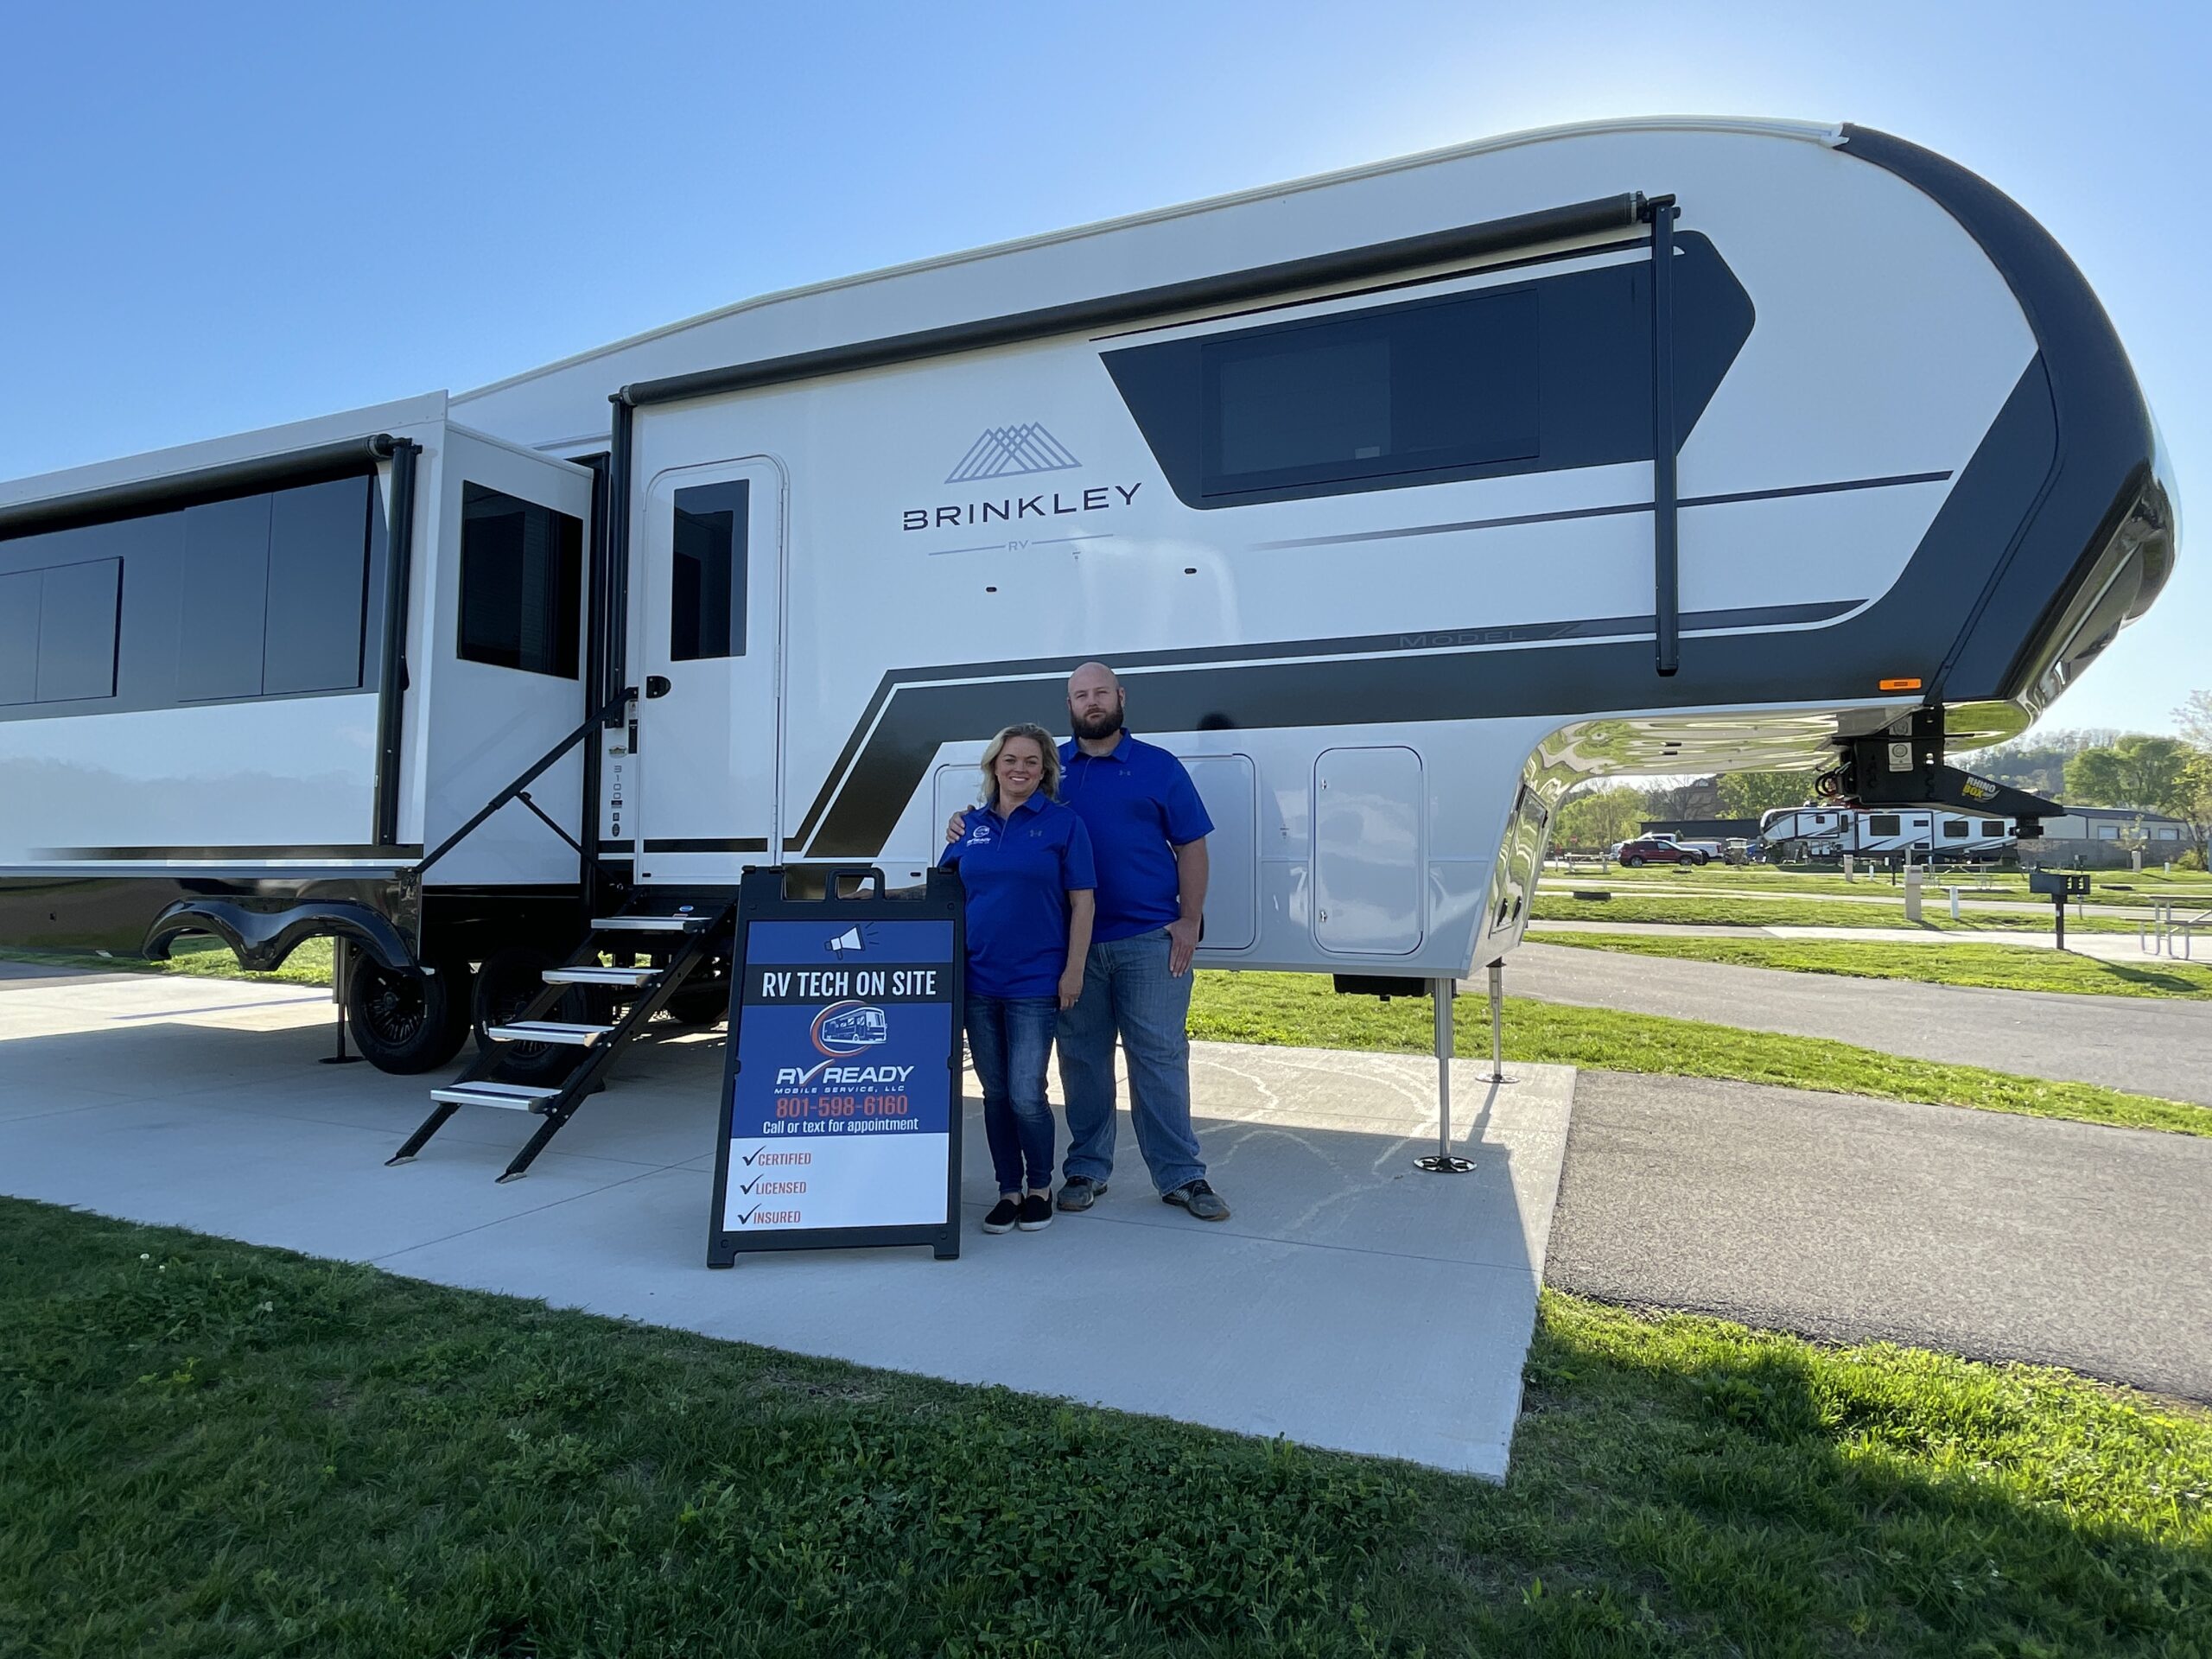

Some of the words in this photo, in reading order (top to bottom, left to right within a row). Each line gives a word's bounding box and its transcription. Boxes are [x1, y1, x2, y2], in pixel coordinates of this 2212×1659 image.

[903, 482, 1141, 531] BRINKLEY
[1008, 539, 1029, 551] RV
[1399, 632, 1528, 648] MODEL
[1548, 624, 1588, 639] Z
[1963, 785, 1984, 798] BOX
[1966, 776, 1996, 793] RHINO
[762, 972, 791, 997] RV
[797, 972, 849, 997] TECH
[856, 970, 885, 995] ON
[892, 970, 937, 995] SITE
[776, 1058, 836, 1086] RV
[823, 1065, 914, 1084] READY
[824, 1085, 878, 1094] SERVICE,
[776, 1095, 908, 1118] 801-598-6160
[763, 1121, 785, 1134] Call
[787, 1123, 799, 1134] or
[803, 1122, 825, 1133] text
[829, 1120, 844, 1132] for
[848, 1118, 918, 1134] appointment
[758, 1153, 811, 1166] CERTIFIED
[755, 1181, 807, 1195] LICENSED
[753, 1211, 801, 1224] INSURED
